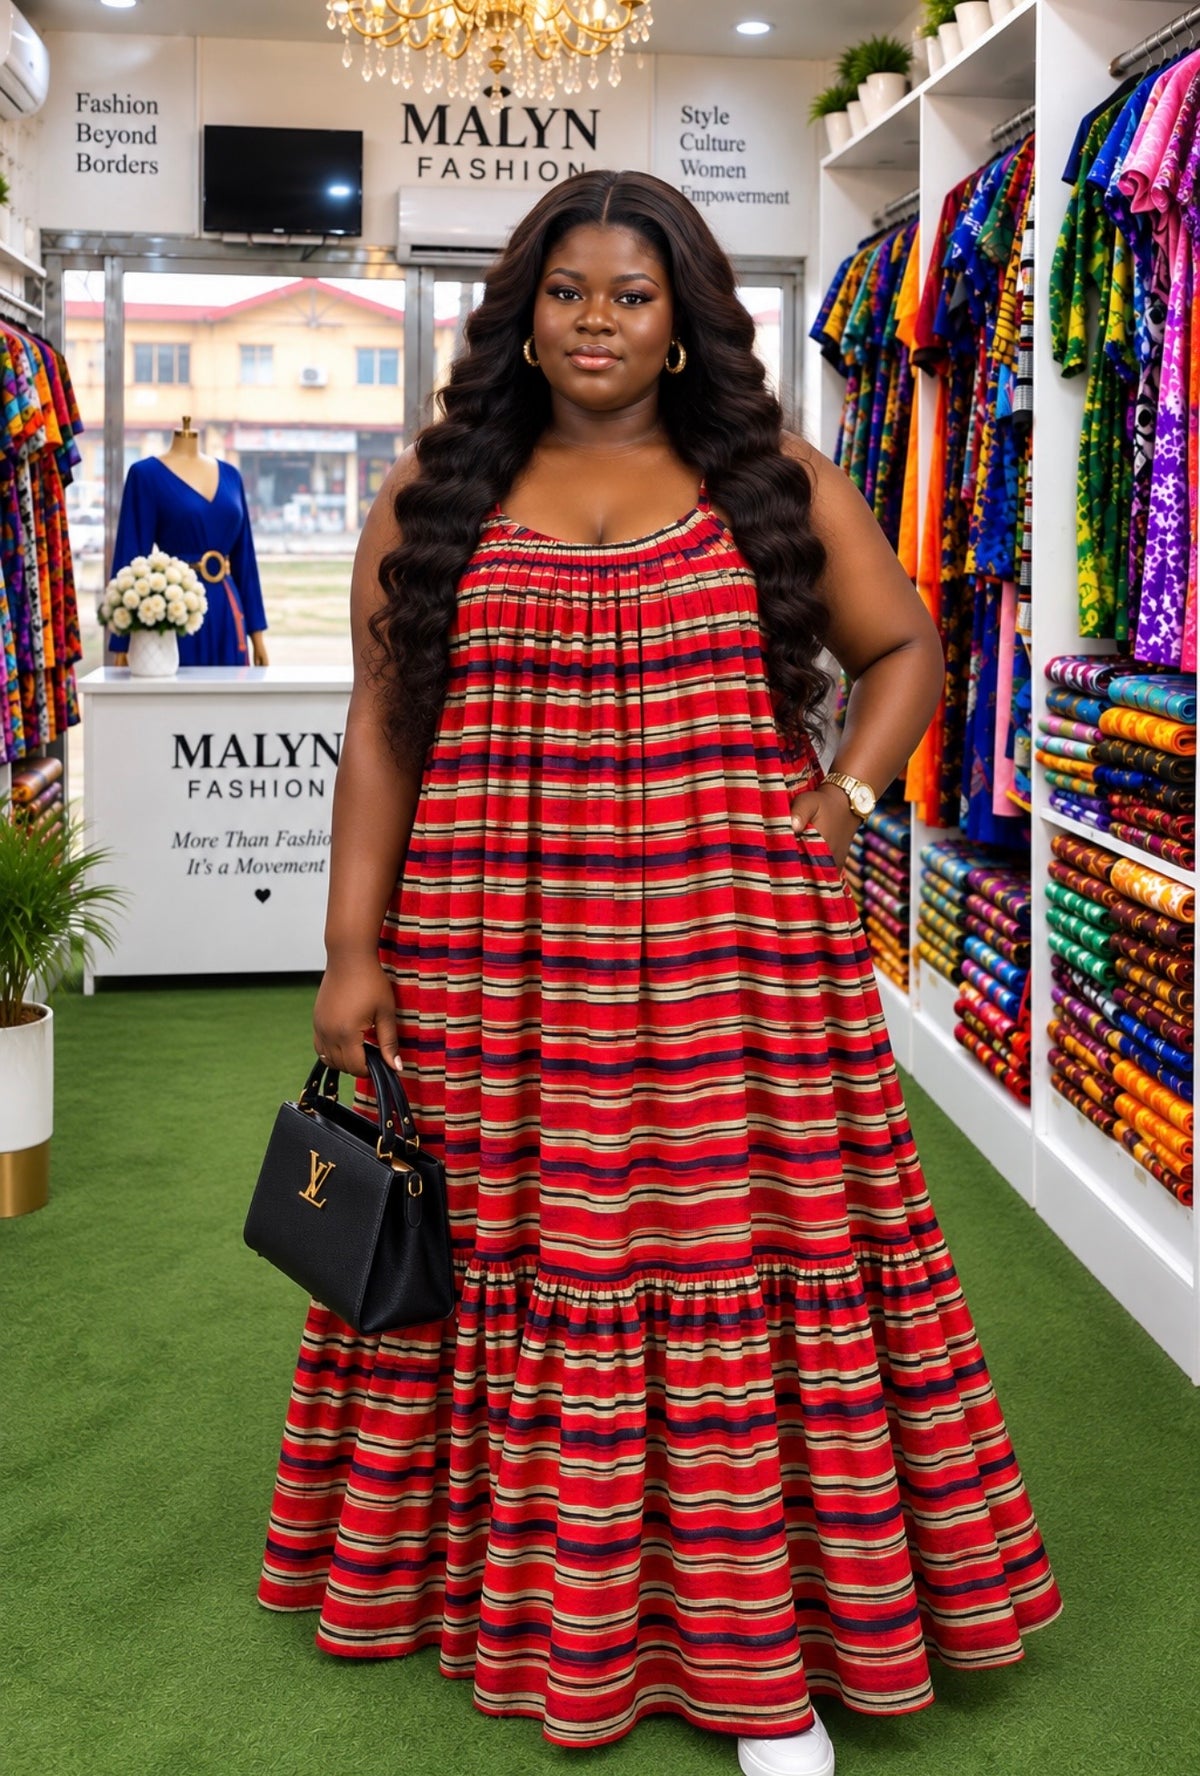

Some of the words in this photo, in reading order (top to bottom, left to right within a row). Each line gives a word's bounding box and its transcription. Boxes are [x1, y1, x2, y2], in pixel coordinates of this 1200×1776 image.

[76, 92, 159, 115] Fashion
[680, 105, 730, 126] Style
[76, 122, 158, 148] Beyond
[400, 102, 600, 151] MALYN
[680, 133, 746, 153] Culture
[76, 153, 159, 175] Borders
[417, 156, 586, 182] FASHION
[680, 159, 747, 180] Women
[172, 732, 343, 769] MALYN
[188, 779, 325, 799] FASHION
[171, 831, 219, 849] More
[225, 831, 269, 849] Than
[274, 830, 332, 848] Fashio
[186, 858, 212, 876] It's
[217, 863, 229, 875] a
[234, 857, 326, 876] Movement
